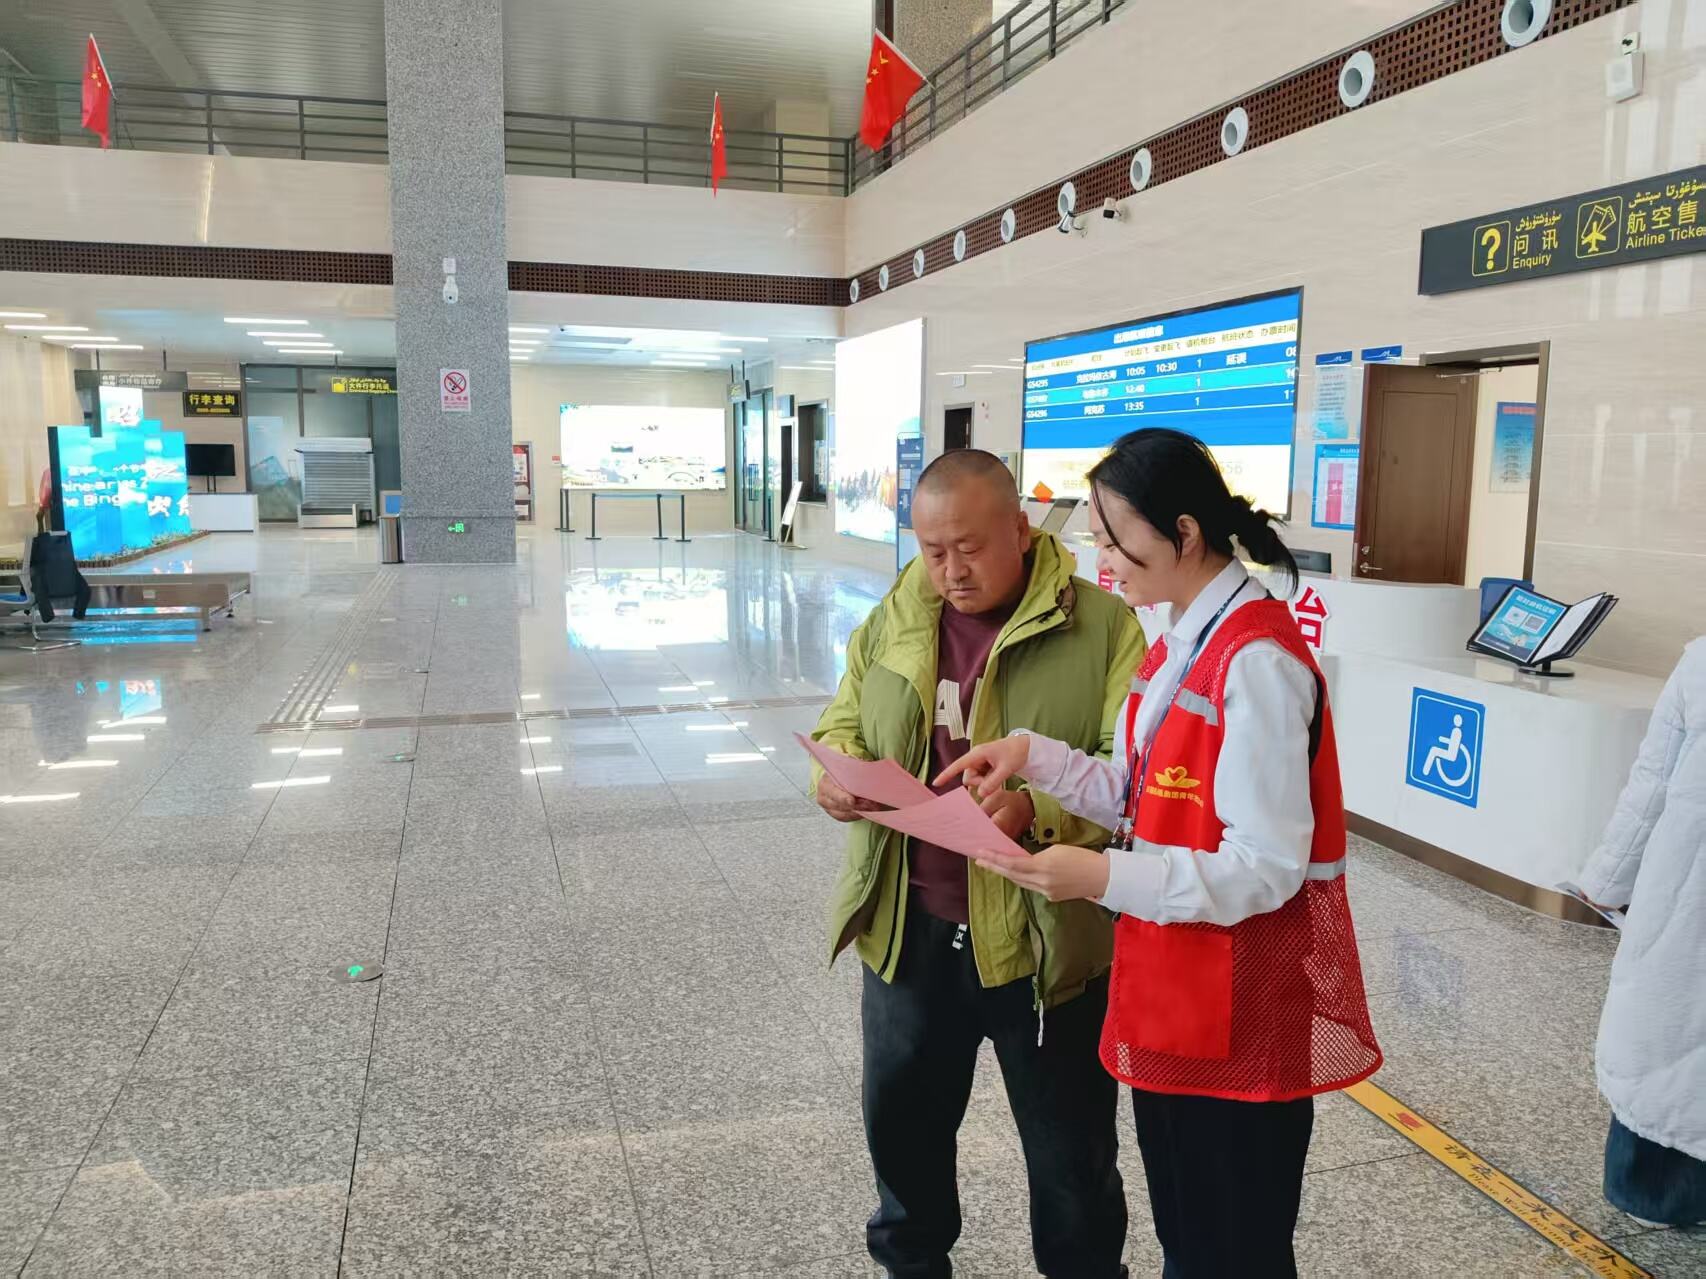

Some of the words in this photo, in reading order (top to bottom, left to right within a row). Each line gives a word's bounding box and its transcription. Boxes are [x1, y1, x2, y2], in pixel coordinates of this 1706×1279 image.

[1627, 200, 1698, 235] 航空售
[1513, 229, 1559, 256] 问讯
[1626, 232, 1666, 249] Airline
[1512, 253, 1552, 269] Enquiry
[1126, 366, 1146, 377] 10:05
[1156, 361, 1178, 374] 10:30
[1197, 358, 1202, 368] 1
[1196, 377, 1201, 387] 1
[189, 394, 235, 405] 行李查询
[1195, 396, 1200, 407] 1
